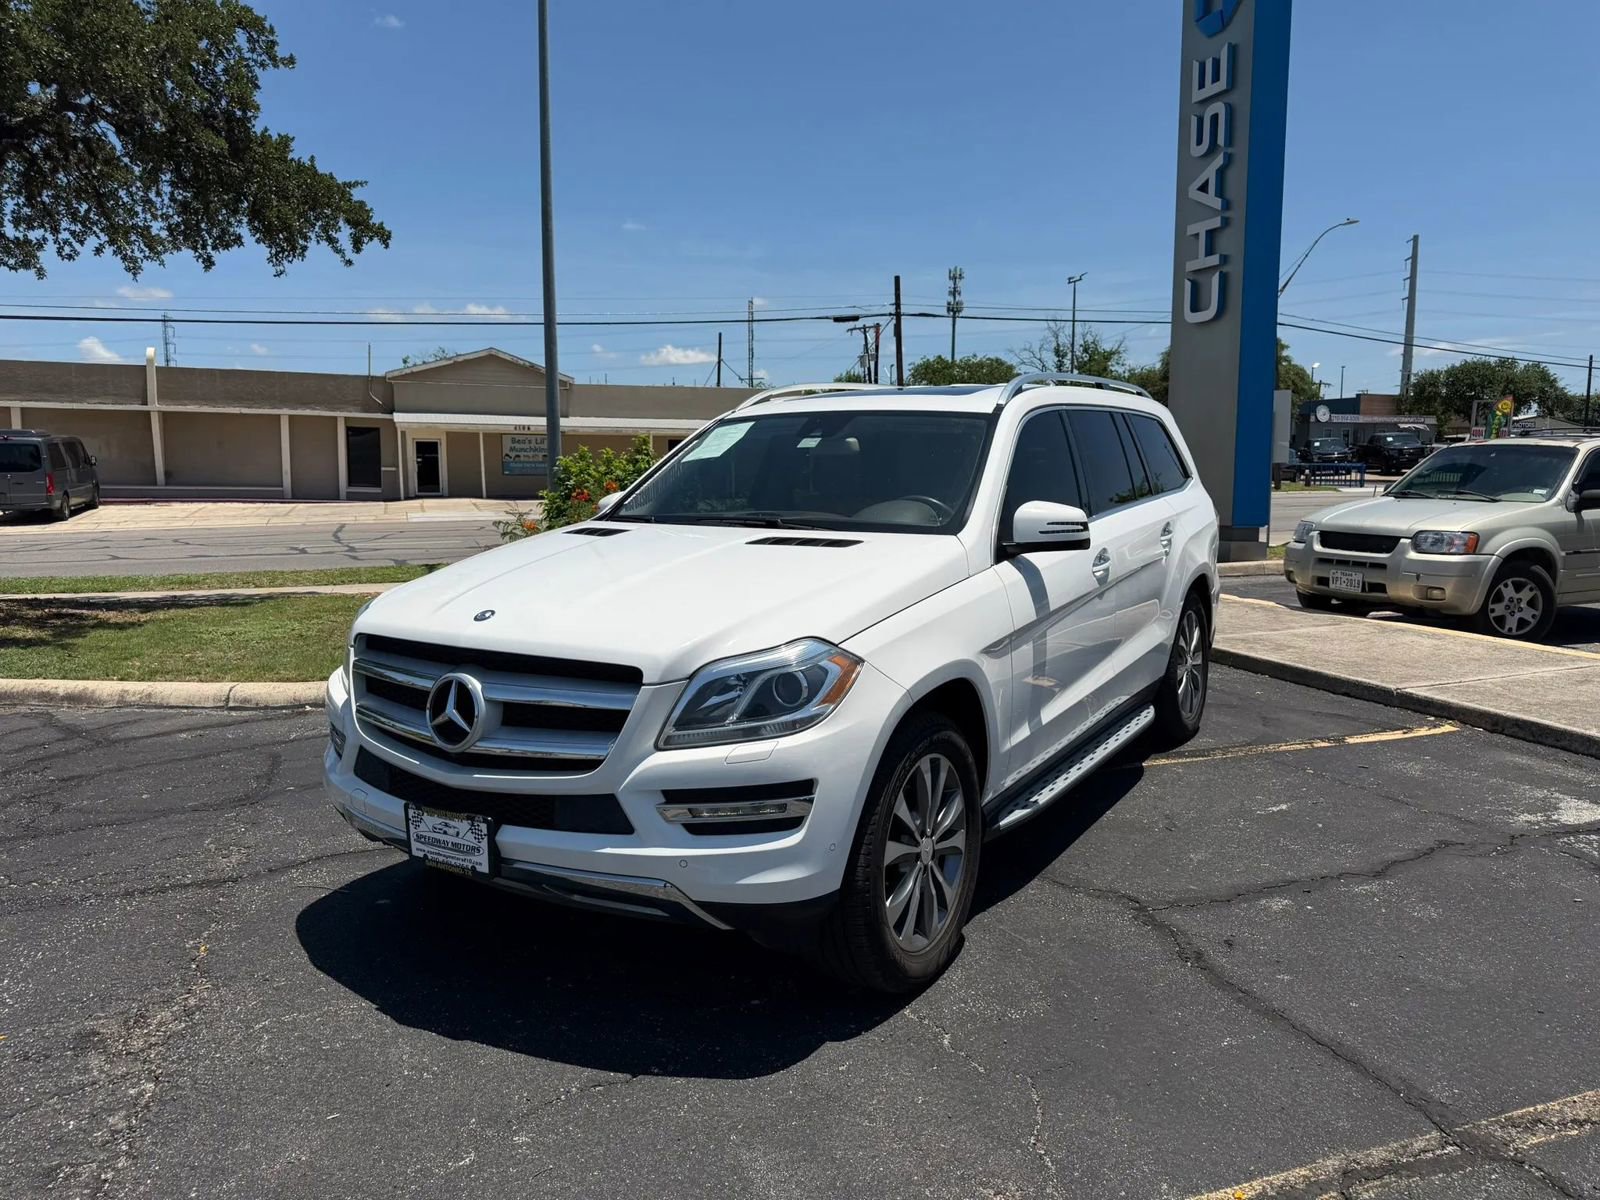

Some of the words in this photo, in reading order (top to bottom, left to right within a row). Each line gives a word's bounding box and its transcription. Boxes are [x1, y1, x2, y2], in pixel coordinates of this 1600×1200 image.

[1184, 42, 1232, 323] CHASE
[415, 833, 451, 848] SPEEDWAY
[450, 841, 481, 854] MOTORS
